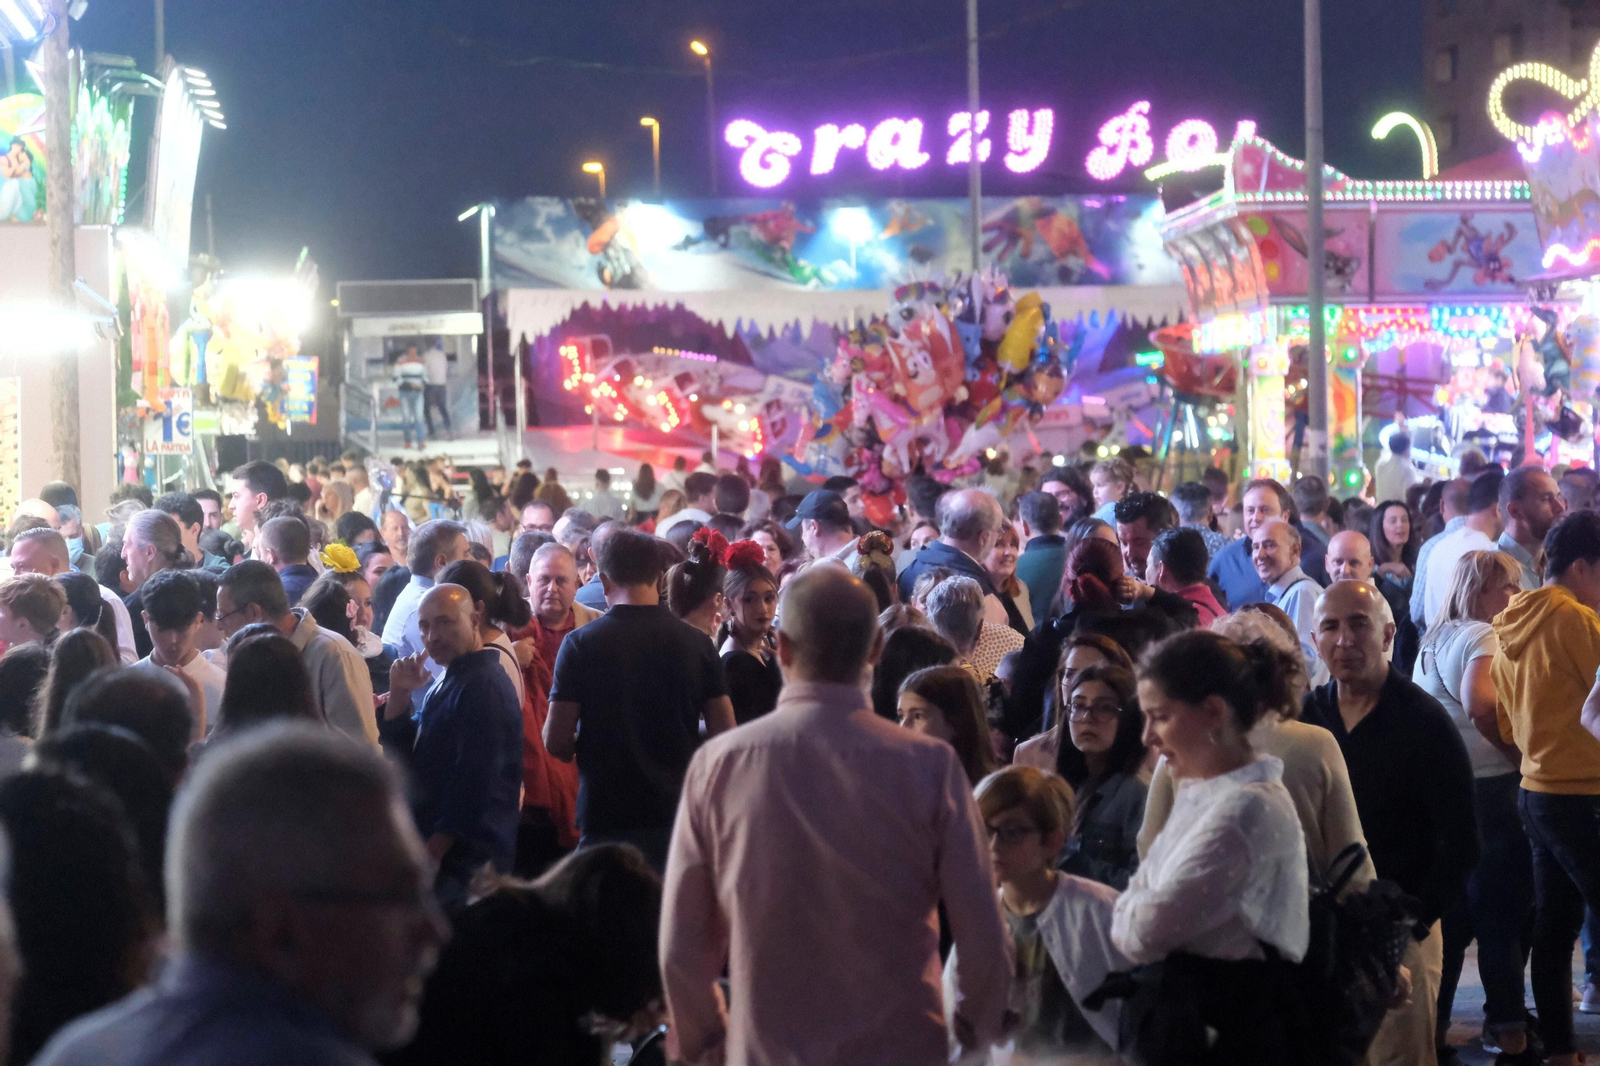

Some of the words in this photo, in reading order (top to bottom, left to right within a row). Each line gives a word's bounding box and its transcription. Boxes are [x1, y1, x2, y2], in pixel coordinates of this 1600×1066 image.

[724, 107, 1054, 188] Crazy
[1085, 101, 1257, 180] Bo
[145, 439, 159, 452] LA
[161, 443, 191, 452] PARTIDA
